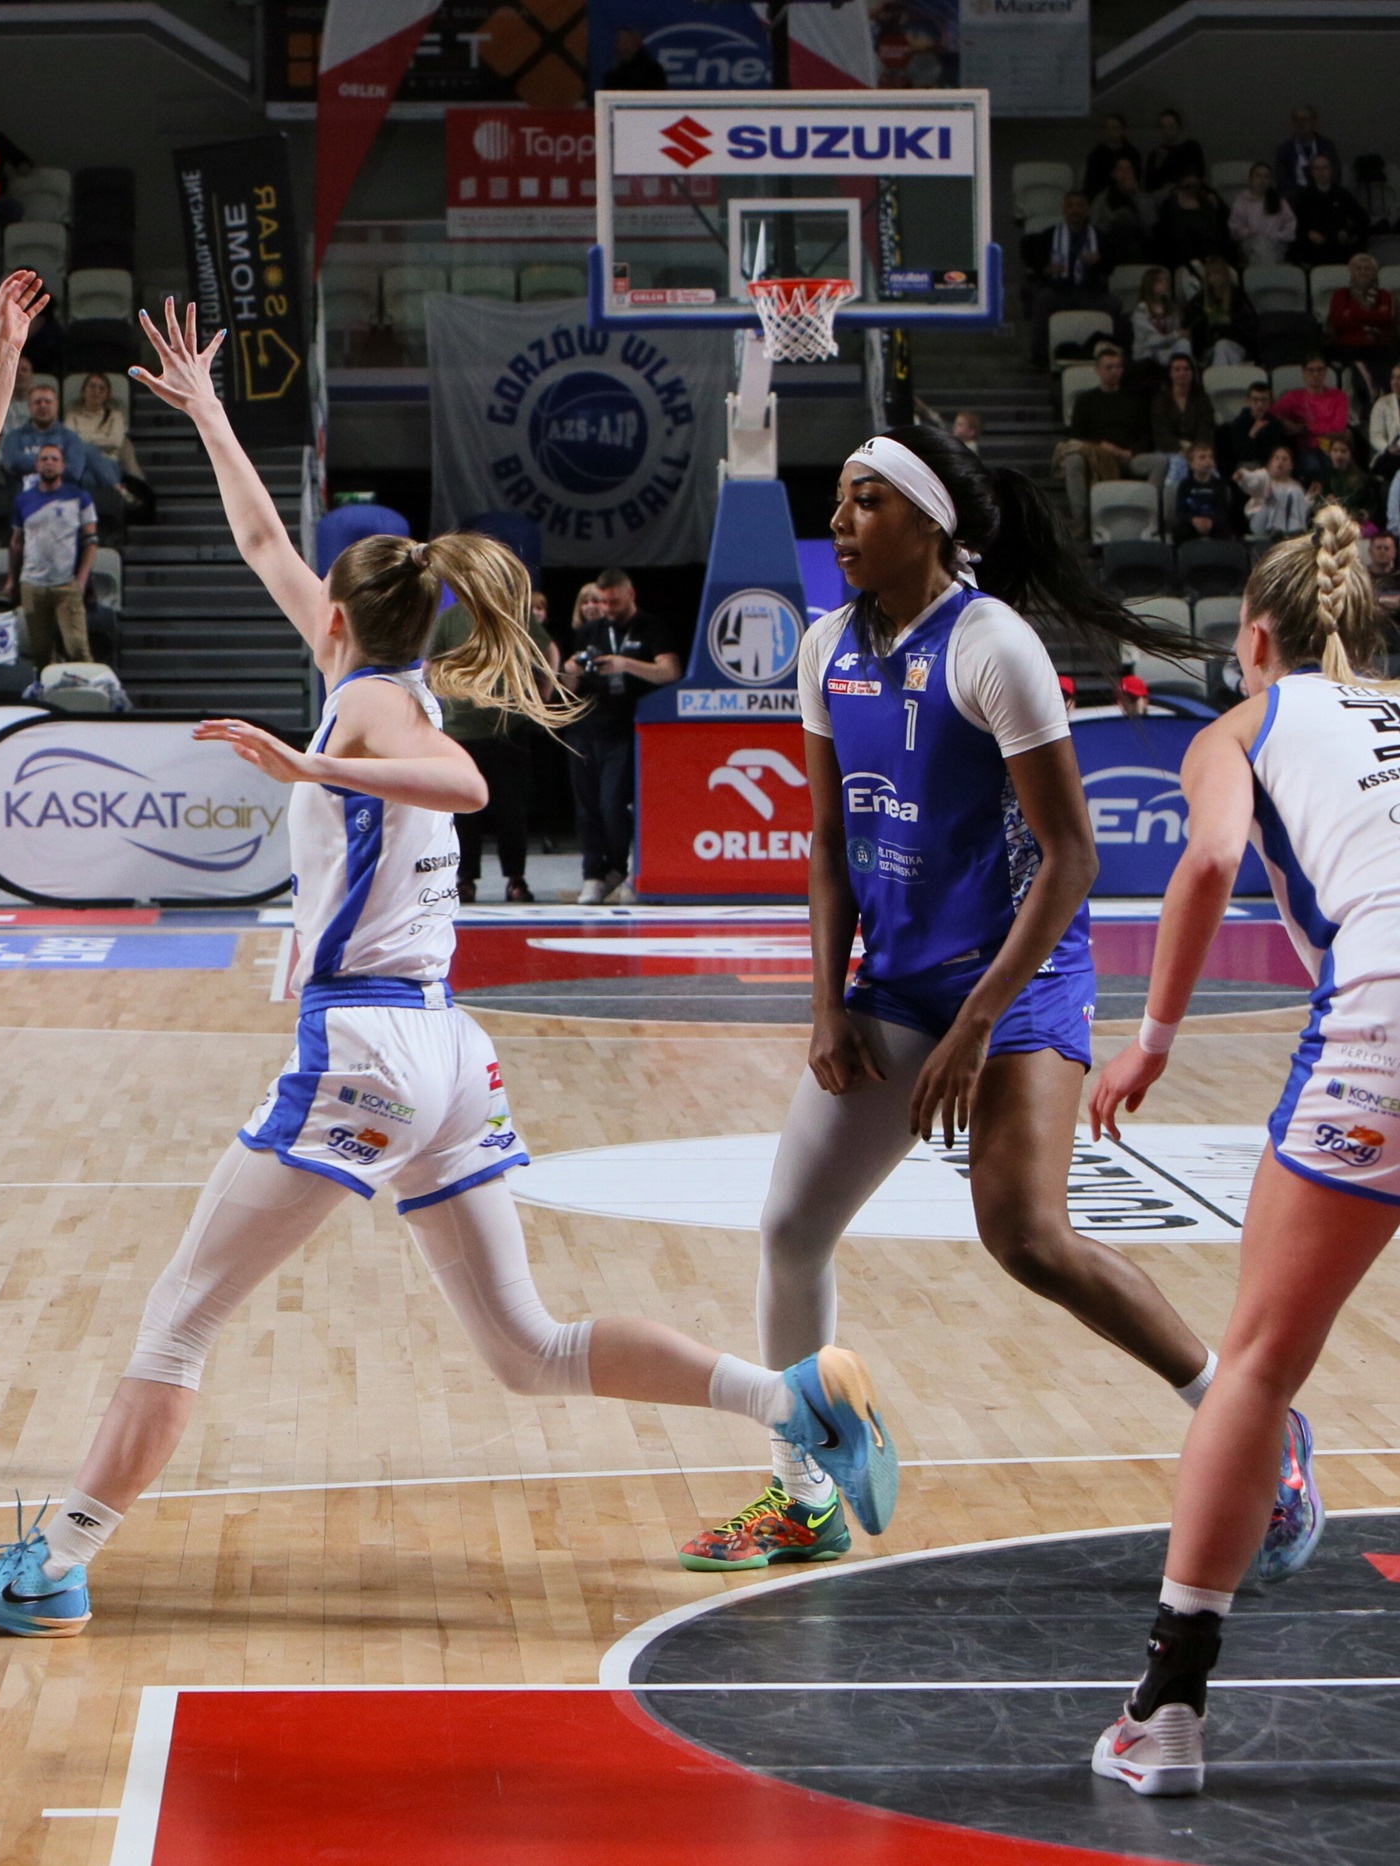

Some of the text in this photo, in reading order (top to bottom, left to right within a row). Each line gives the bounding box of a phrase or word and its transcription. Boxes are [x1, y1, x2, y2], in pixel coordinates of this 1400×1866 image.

[659, 49, 772, 87] Ene
[337, 83, 387, 98] ORLEN
[727, 125, 952, 160] SUZUKI
[487, 324, 610, 427] GORZÓW
[491, 453, 692, 541] BASKETBALL
[834, 652, 859, 671] 4F
[681, 693, 744, 711] P.Z.M.
[903, 699, 919, 751] 1
[848, 788, 919, 823] Enea
[1087, 798, 1190, 844] En
[692, 830, 812, 861] ORLEN
[360, 1092, 416, 1119] KONCEPT
[327, 1126, 382, 1162] Foxy
[1314, 1122, 1377, 1164] Foxy
[66, 1511, 103, 1528] 4F
